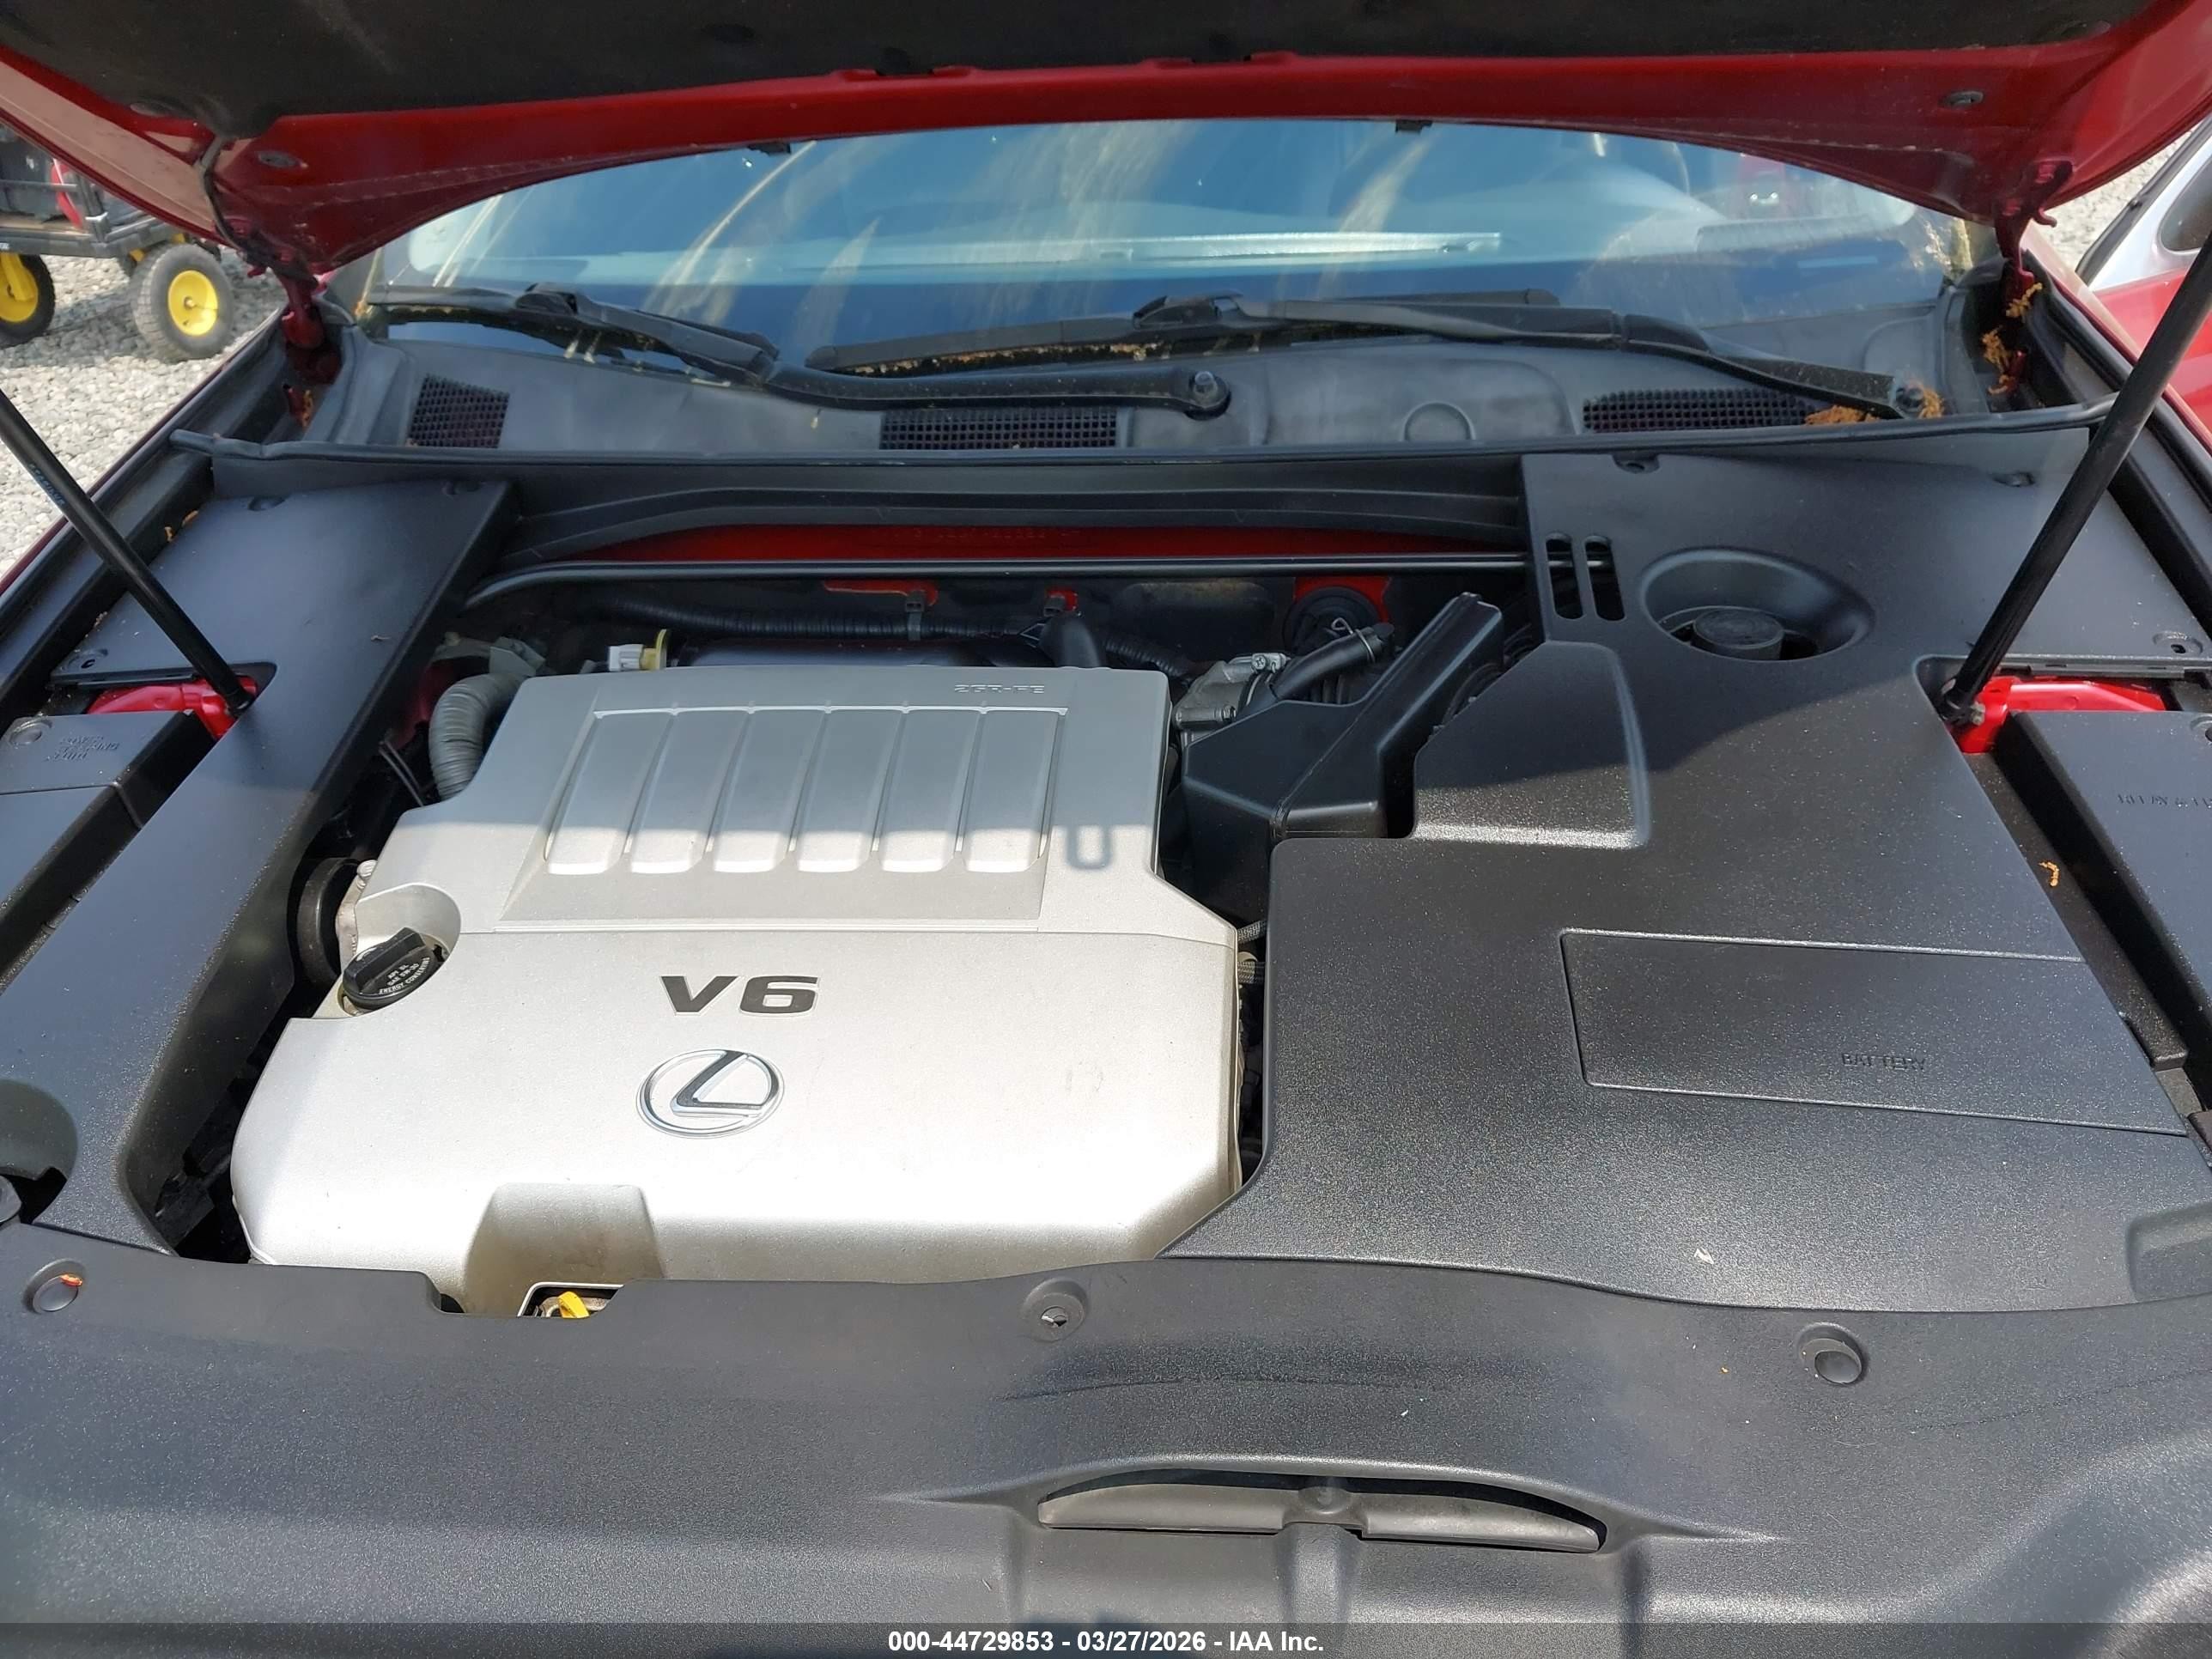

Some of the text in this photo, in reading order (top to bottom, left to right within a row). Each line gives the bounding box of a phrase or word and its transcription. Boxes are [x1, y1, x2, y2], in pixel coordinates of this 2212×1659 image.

[954, 684, 1045, 694] 2GR-FE
[379, 957, 430, 994] ENERGY CONSERVING
[660, 975, 819, 1014] V6
[1841, 1053, 1926, 1070] BATTERY
